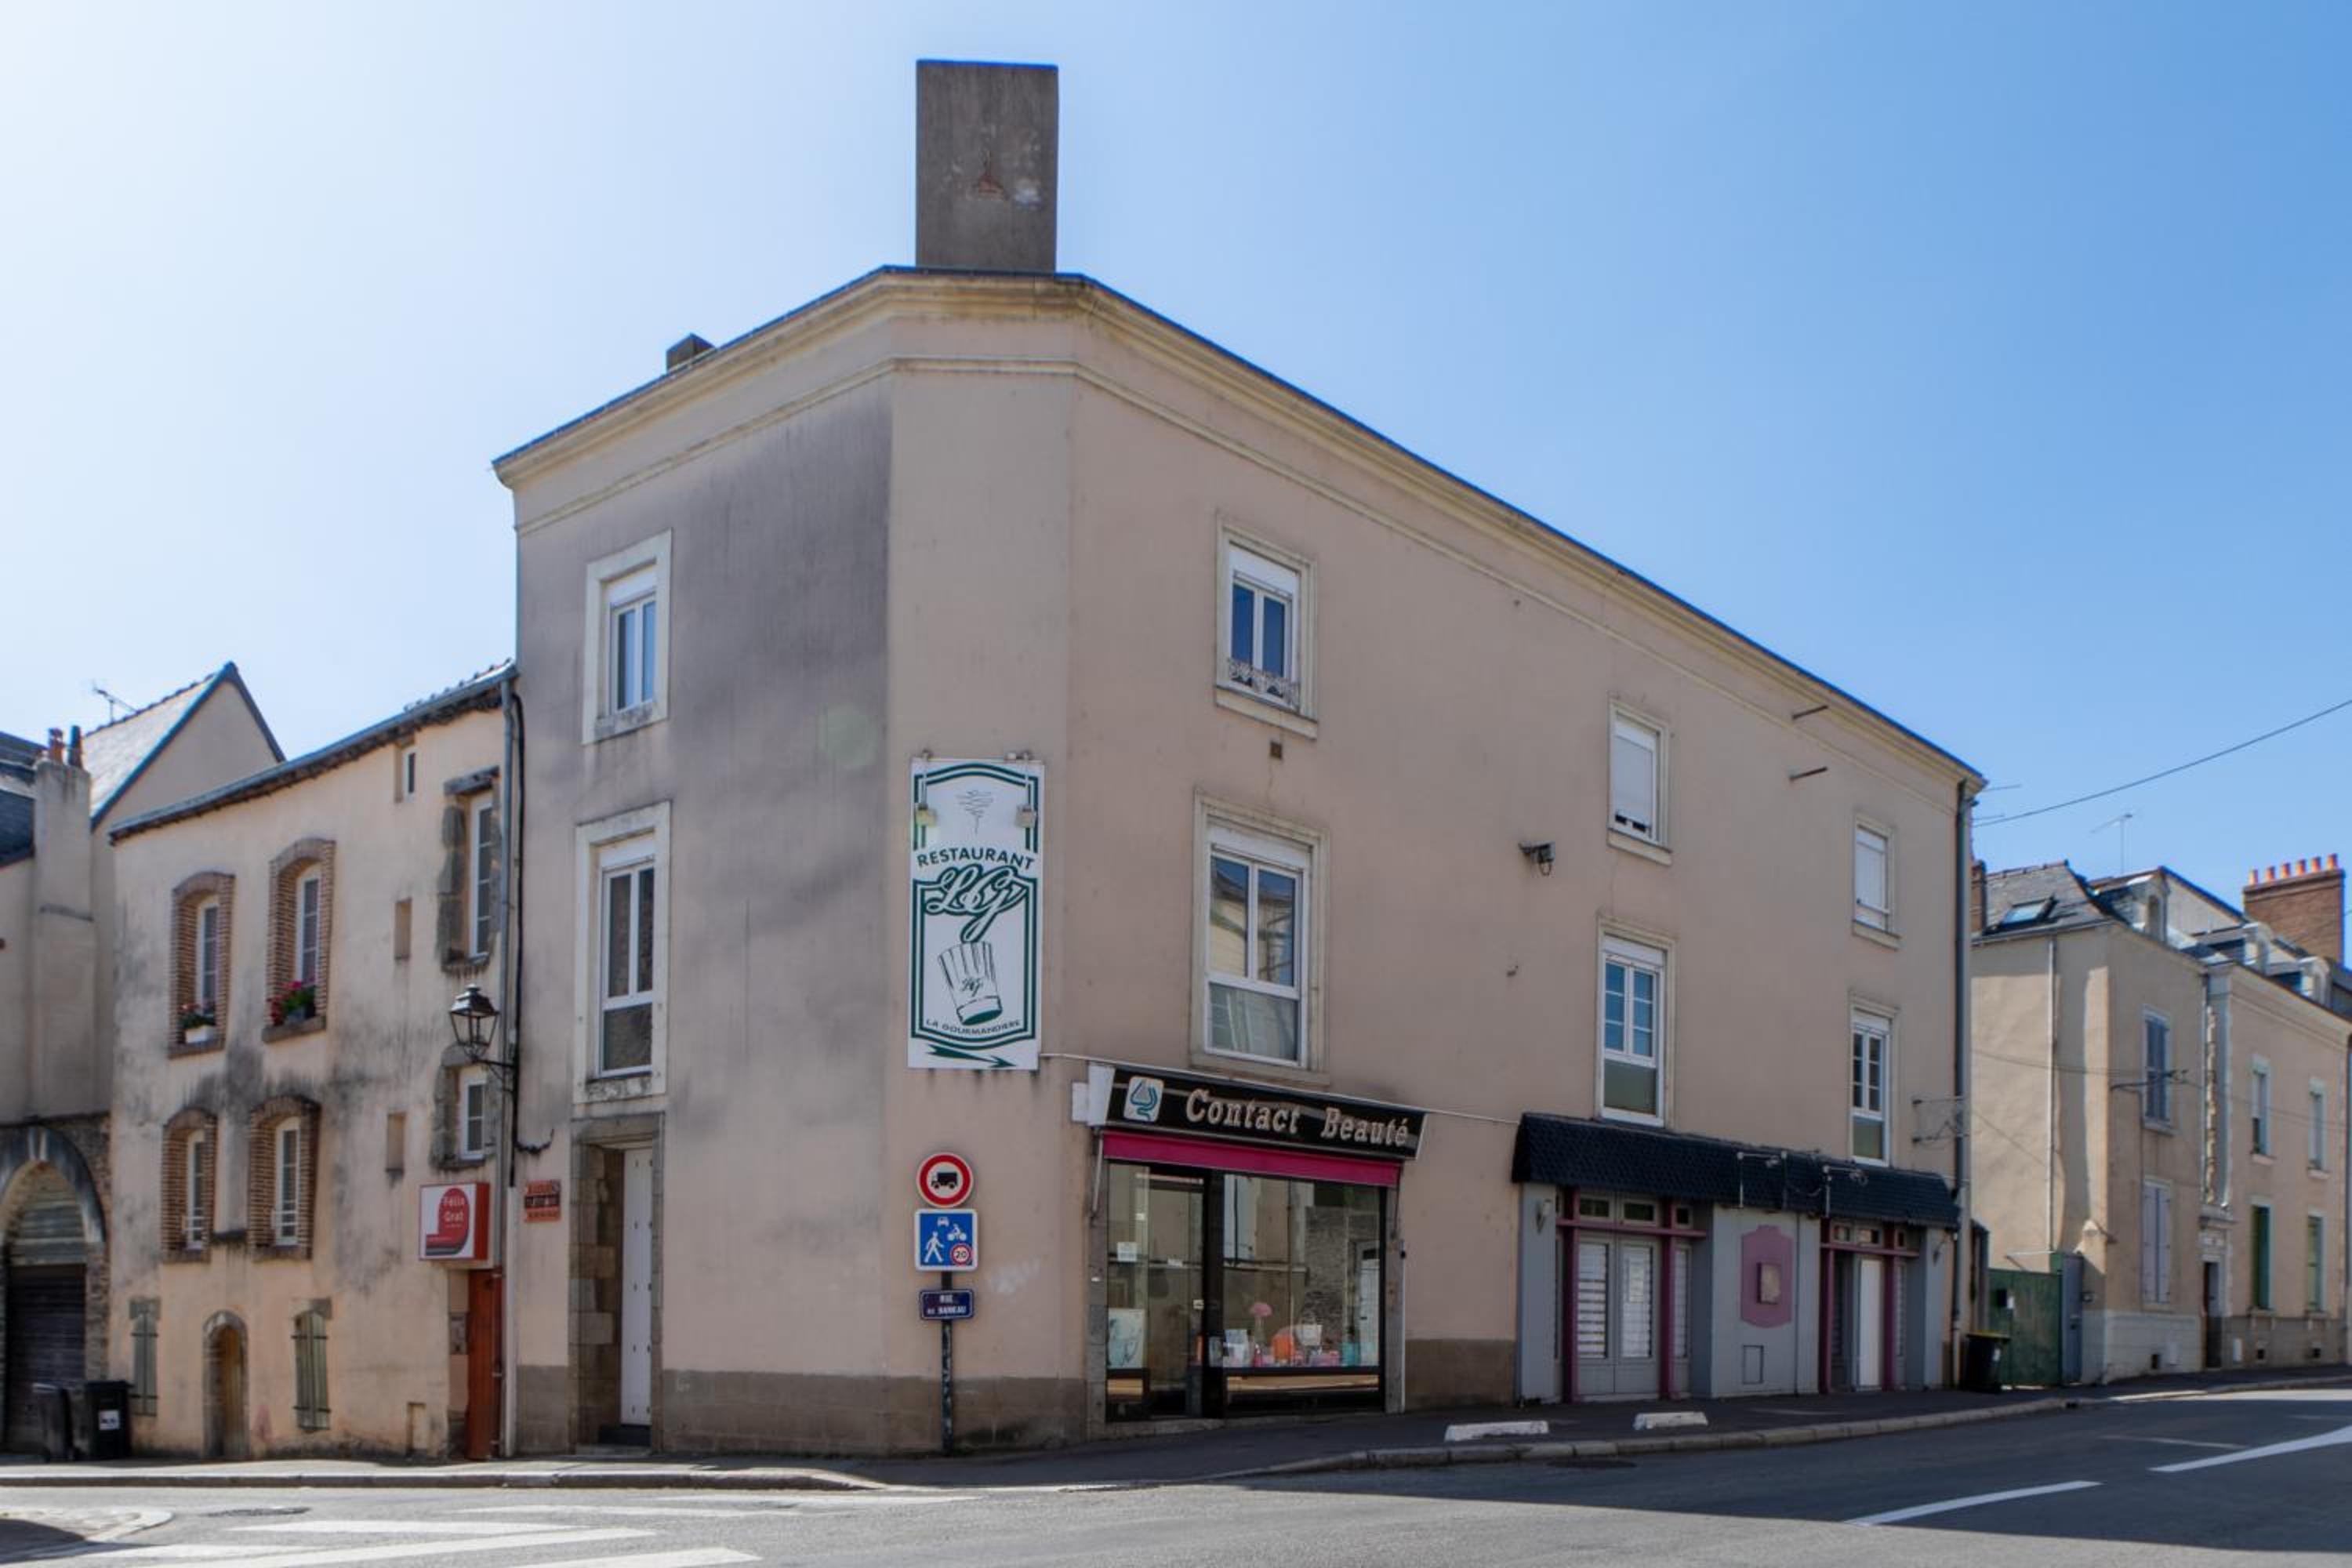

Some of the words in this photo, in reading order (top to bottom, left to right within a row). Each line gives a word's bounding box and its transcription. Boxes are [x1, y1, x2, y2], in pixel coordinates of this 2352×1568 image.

[916, 847, 1035, 870] RESTAURANT
[926, 1018, 938, 1029] LA
[1185, 1088, 1301, 1135] Contact
[1320, 1107, 1410, 1147] Beauté
